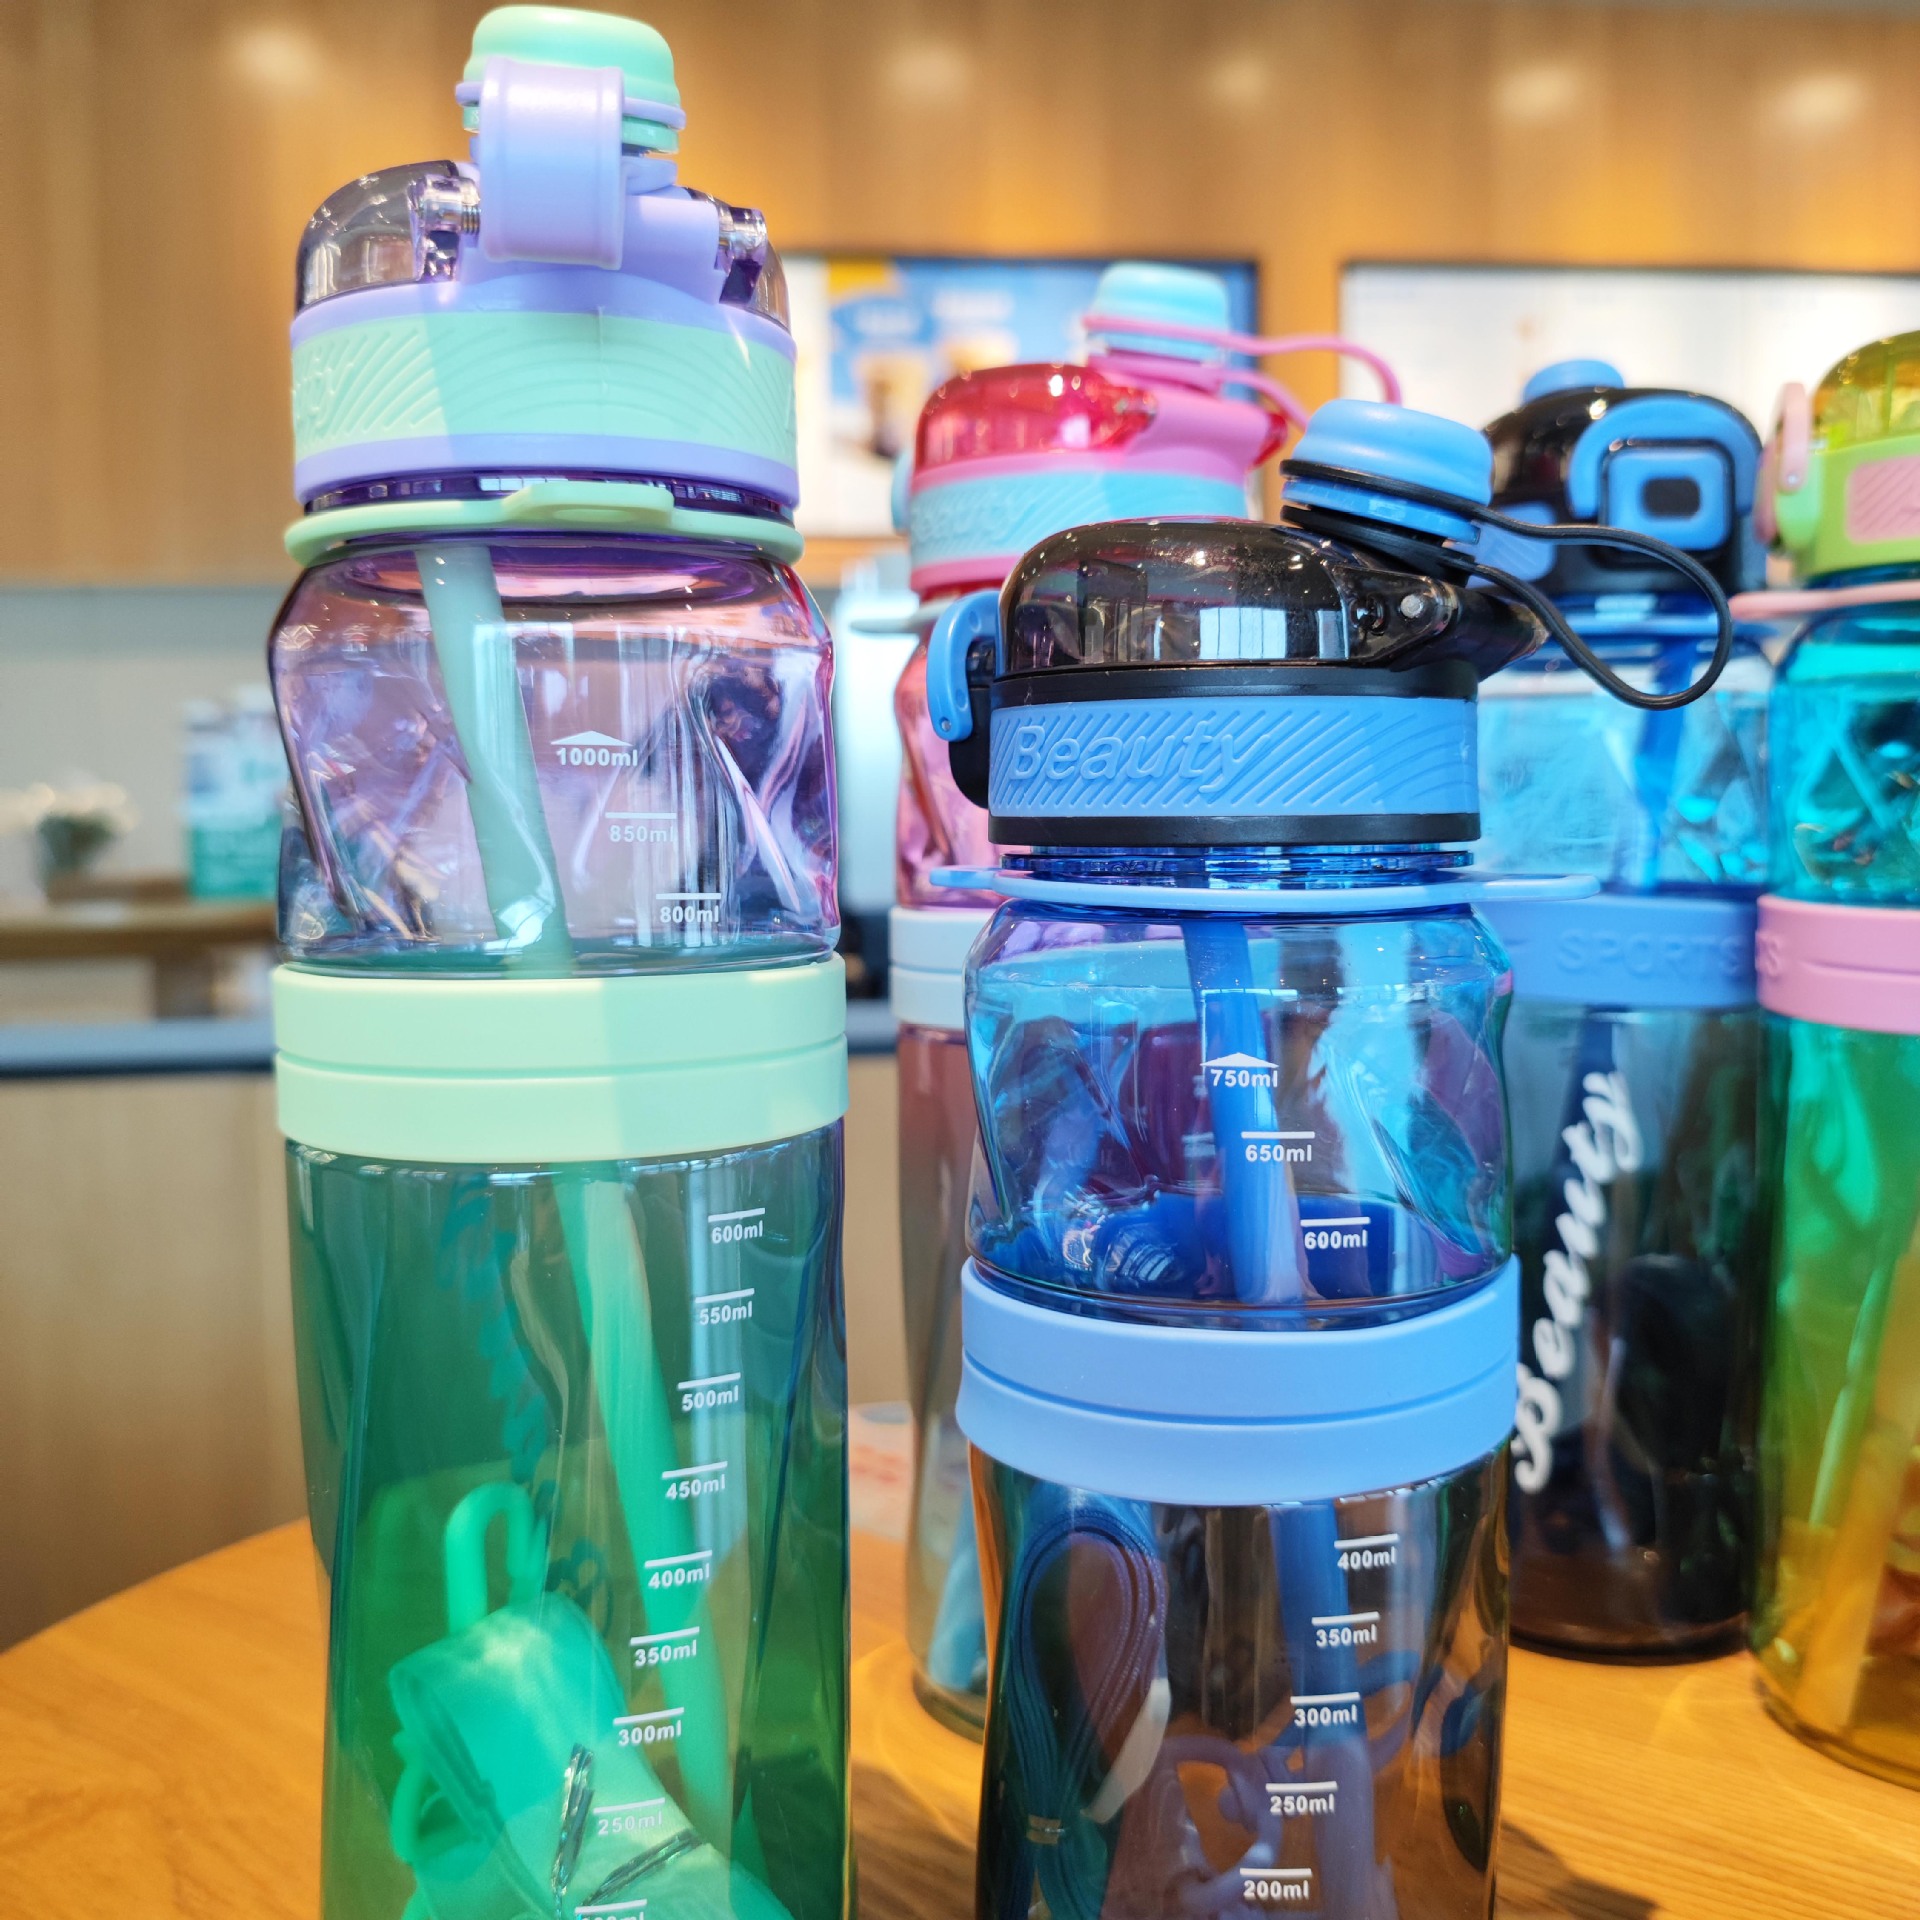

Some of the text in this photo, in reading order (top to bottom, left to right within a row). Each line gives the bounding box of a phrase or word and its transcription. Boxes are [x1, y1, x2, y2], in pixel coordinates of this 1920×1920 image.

[557, 748, 639, 767] 1000ml
[1008, 720, 1264, 794] Beauty
[609, 825, 675, 843] 850ml
[659, 905, 720, 924] 800ml
[1210, 1069, 1279, 1088] 750ml
[1245, 1144, 1313, 1162] 650ml
[711, 1221, 763, 1243] 600ml
[1304, 1230, 1368, 1249] 600ml
[699, 1301, 753, 1325] 550ml
[681, 1386, 738, 1411] 500ml
[665, 1475, 726, 1499] 450ml
[1337, 1548, 1396, 1569] 400ml
[648, 1563, 711, 1588] 400ml
[1316, 1624, 1378, 1647] 350ml
[634, 1640, 698, 1667] 350ml
[1294, 1705, 1358, 1727] 300ml
[618, 1720, 682, 1746] 300ml
[1270, 1795, 1335, 1815] 250ml
[598, 1809, 663, 1834] 250ml
[1243, 1880, 1310, 1900] 200ml
